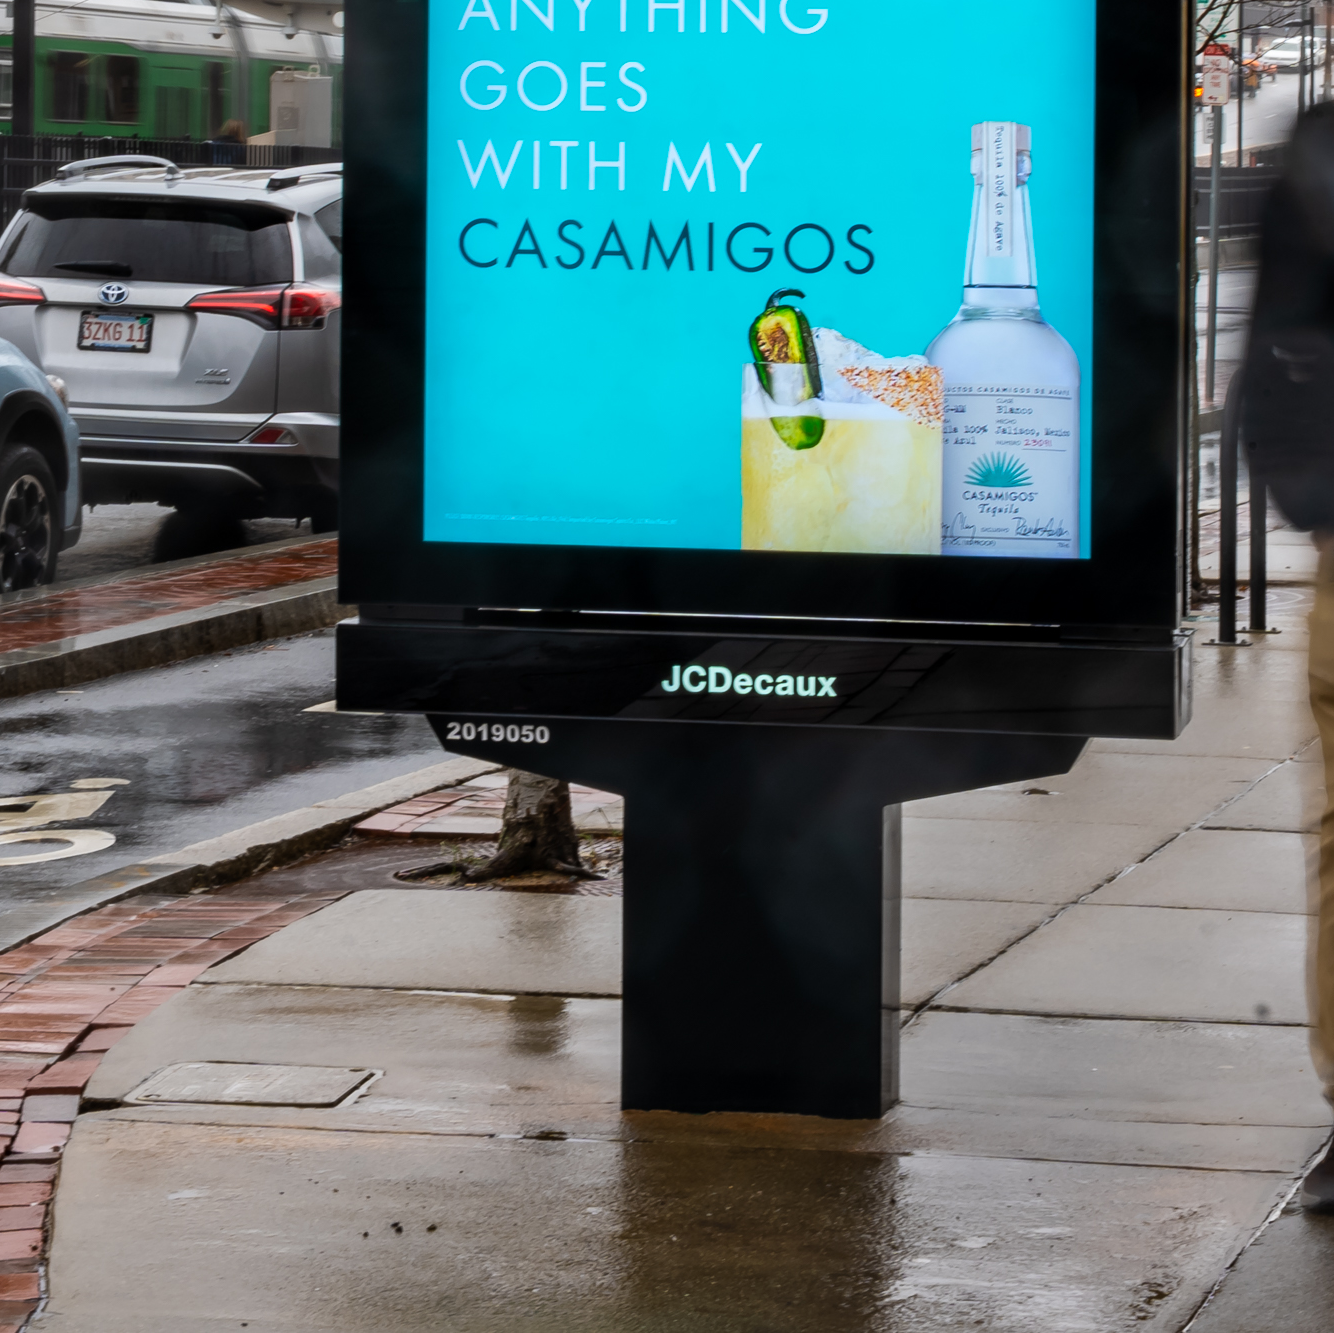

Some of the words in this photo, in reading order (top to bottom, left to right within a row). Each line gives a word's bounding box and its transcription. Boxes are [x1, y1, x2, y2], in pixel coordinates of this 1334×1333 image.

[459, 60, 648, 113] GOES
[994, 126, 1005, 168] Tequila
[457, 139, 626, 191] WITH
[662, 140, 763, 193] MY
[458, 217, 875, 275] CASAMIGOS
[82, 320, 123, 341] 3ZKG
[126, 322, 146, 342] 11
[996, 405, 1033, 415] Blanco
[977, 503, 1020, 517] Tequila
[661, 664, 838, 697] JCDecaux
[445, 722, 551, 744] 2019050
